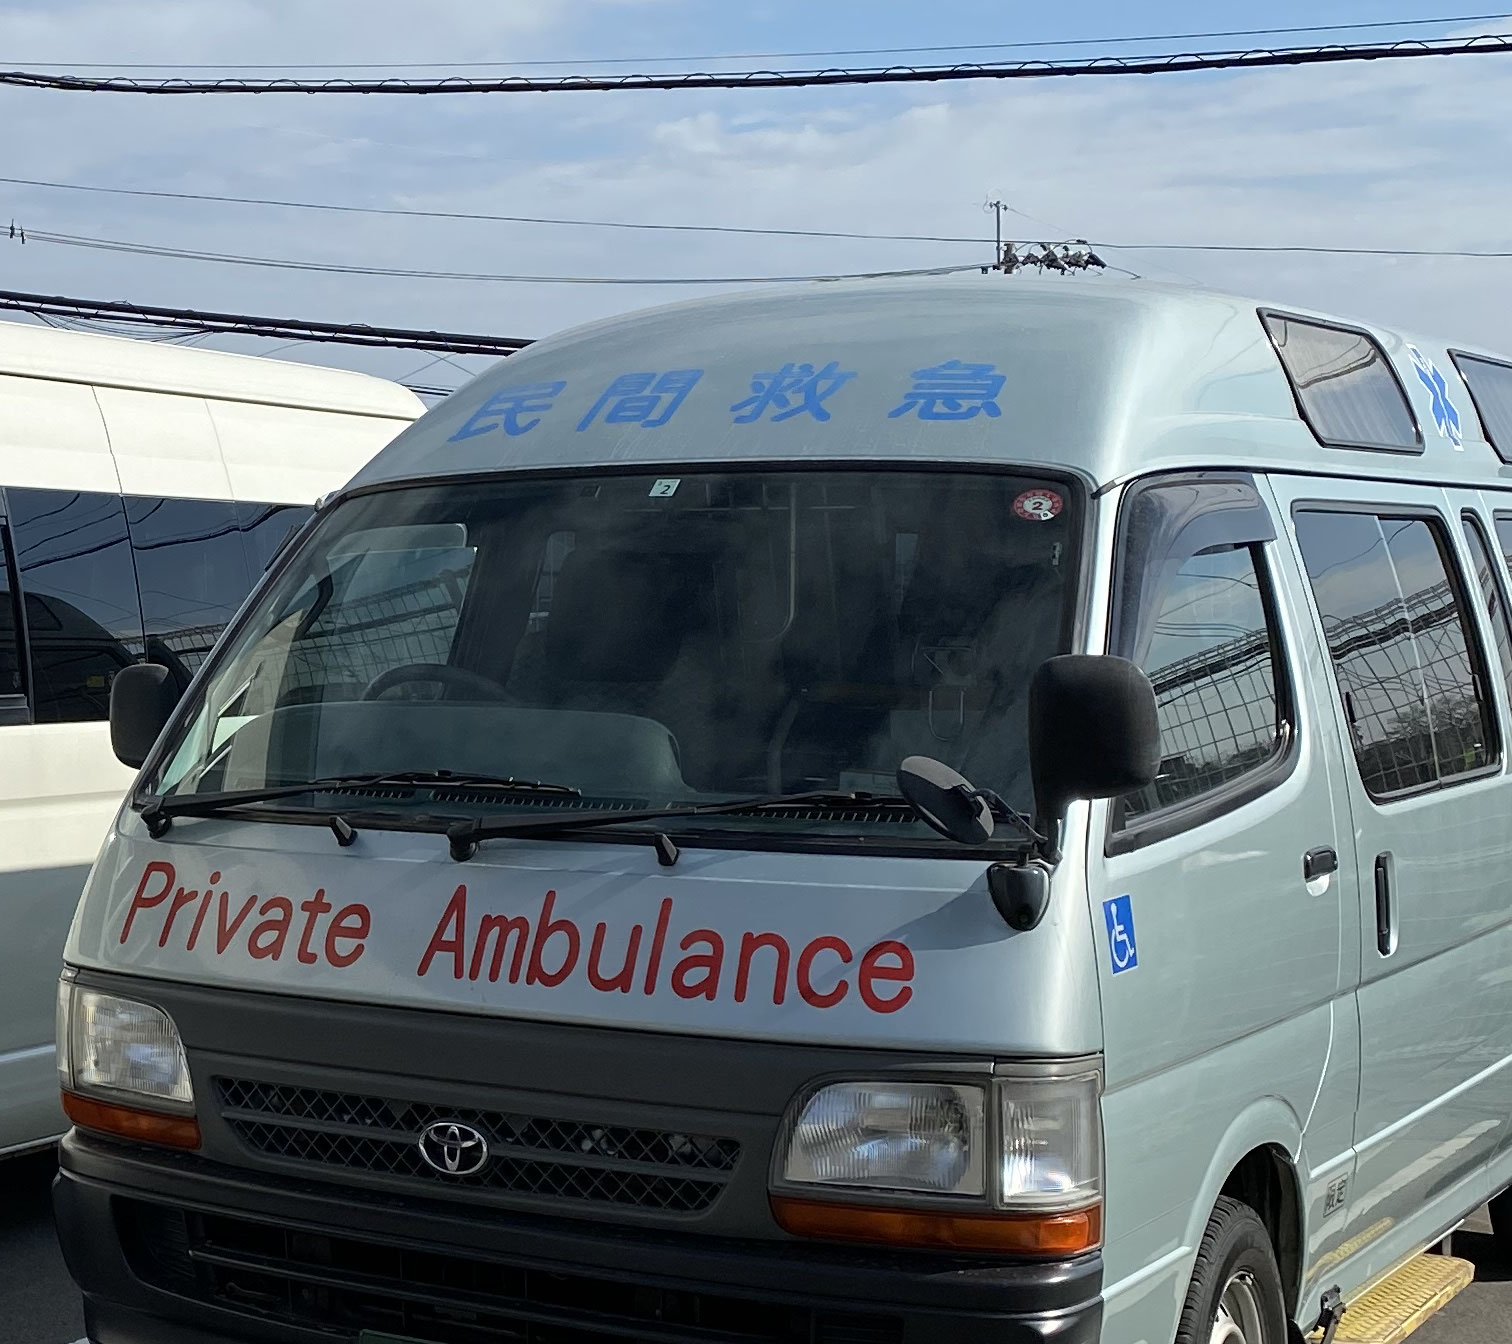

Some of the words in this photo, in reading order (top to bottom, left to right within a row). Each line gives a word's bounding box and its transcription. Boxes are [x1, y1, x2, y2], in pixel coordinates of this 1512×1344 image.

[447, 359, 1007, 442] 民間救急
[659, 484, 671, 495] 2
[1031, 501, 1044, 511] 2
[119, 861, 371, 968] Private
[416, 884, 915, 1014] Ambulance
